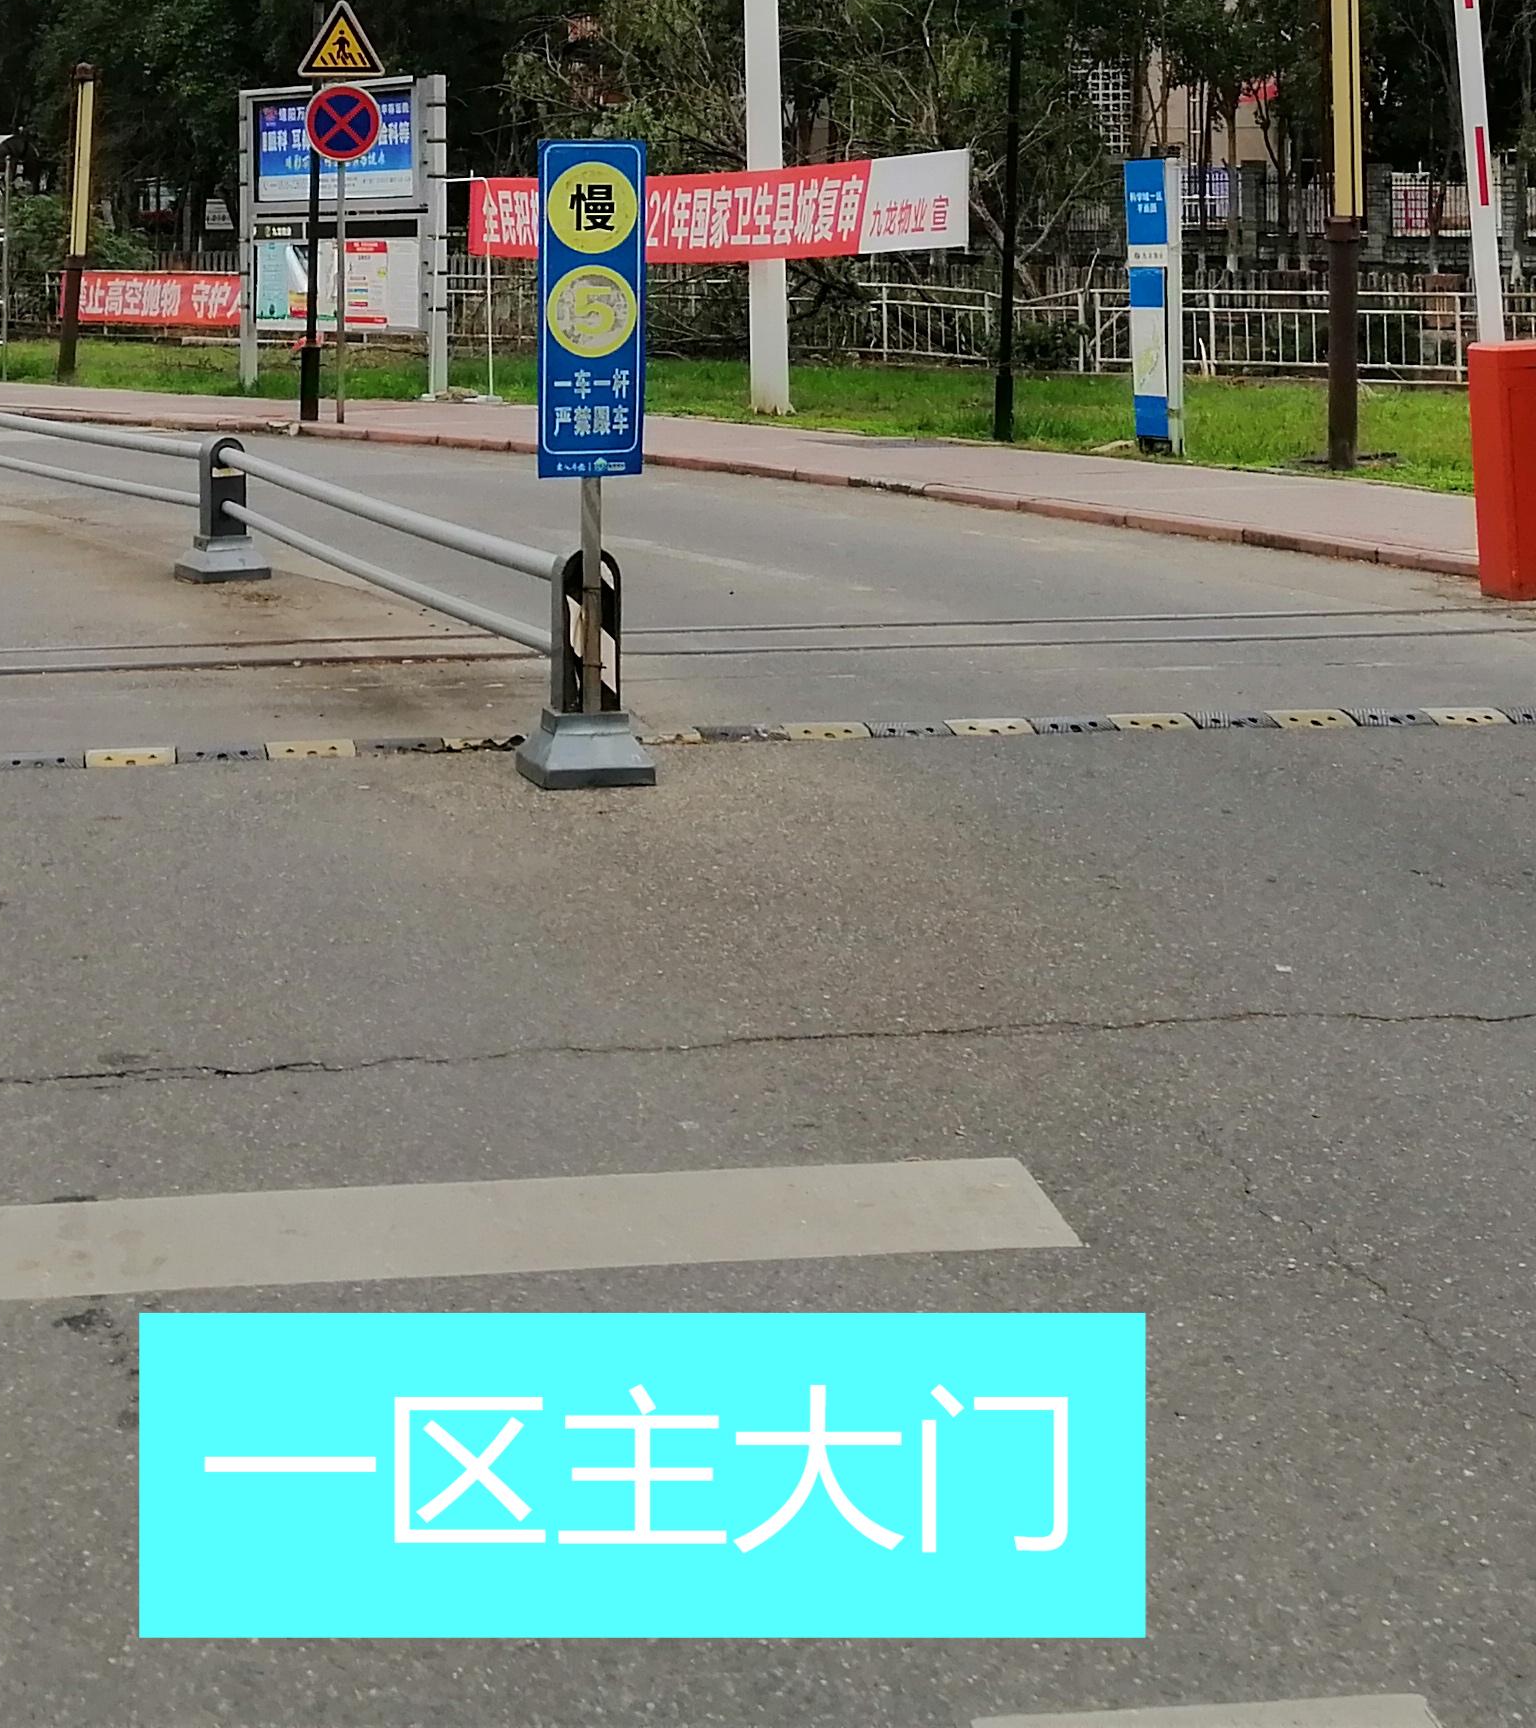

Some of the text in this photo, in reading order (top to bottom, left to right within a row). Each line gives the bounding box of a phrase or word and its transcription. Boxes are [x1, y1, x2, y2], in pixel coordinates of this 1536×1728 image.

[568, 183, 616, 232] 慢
[645, 173, 864, 250] 21年国家卫生县城复审
[869, 194, 950, 238] 九龙物业 宣
[574, 286, 616, 336] 5
[553, 367, 630, 400] 一车一杆
[553, 404, 630, 437] 严禁跟车
